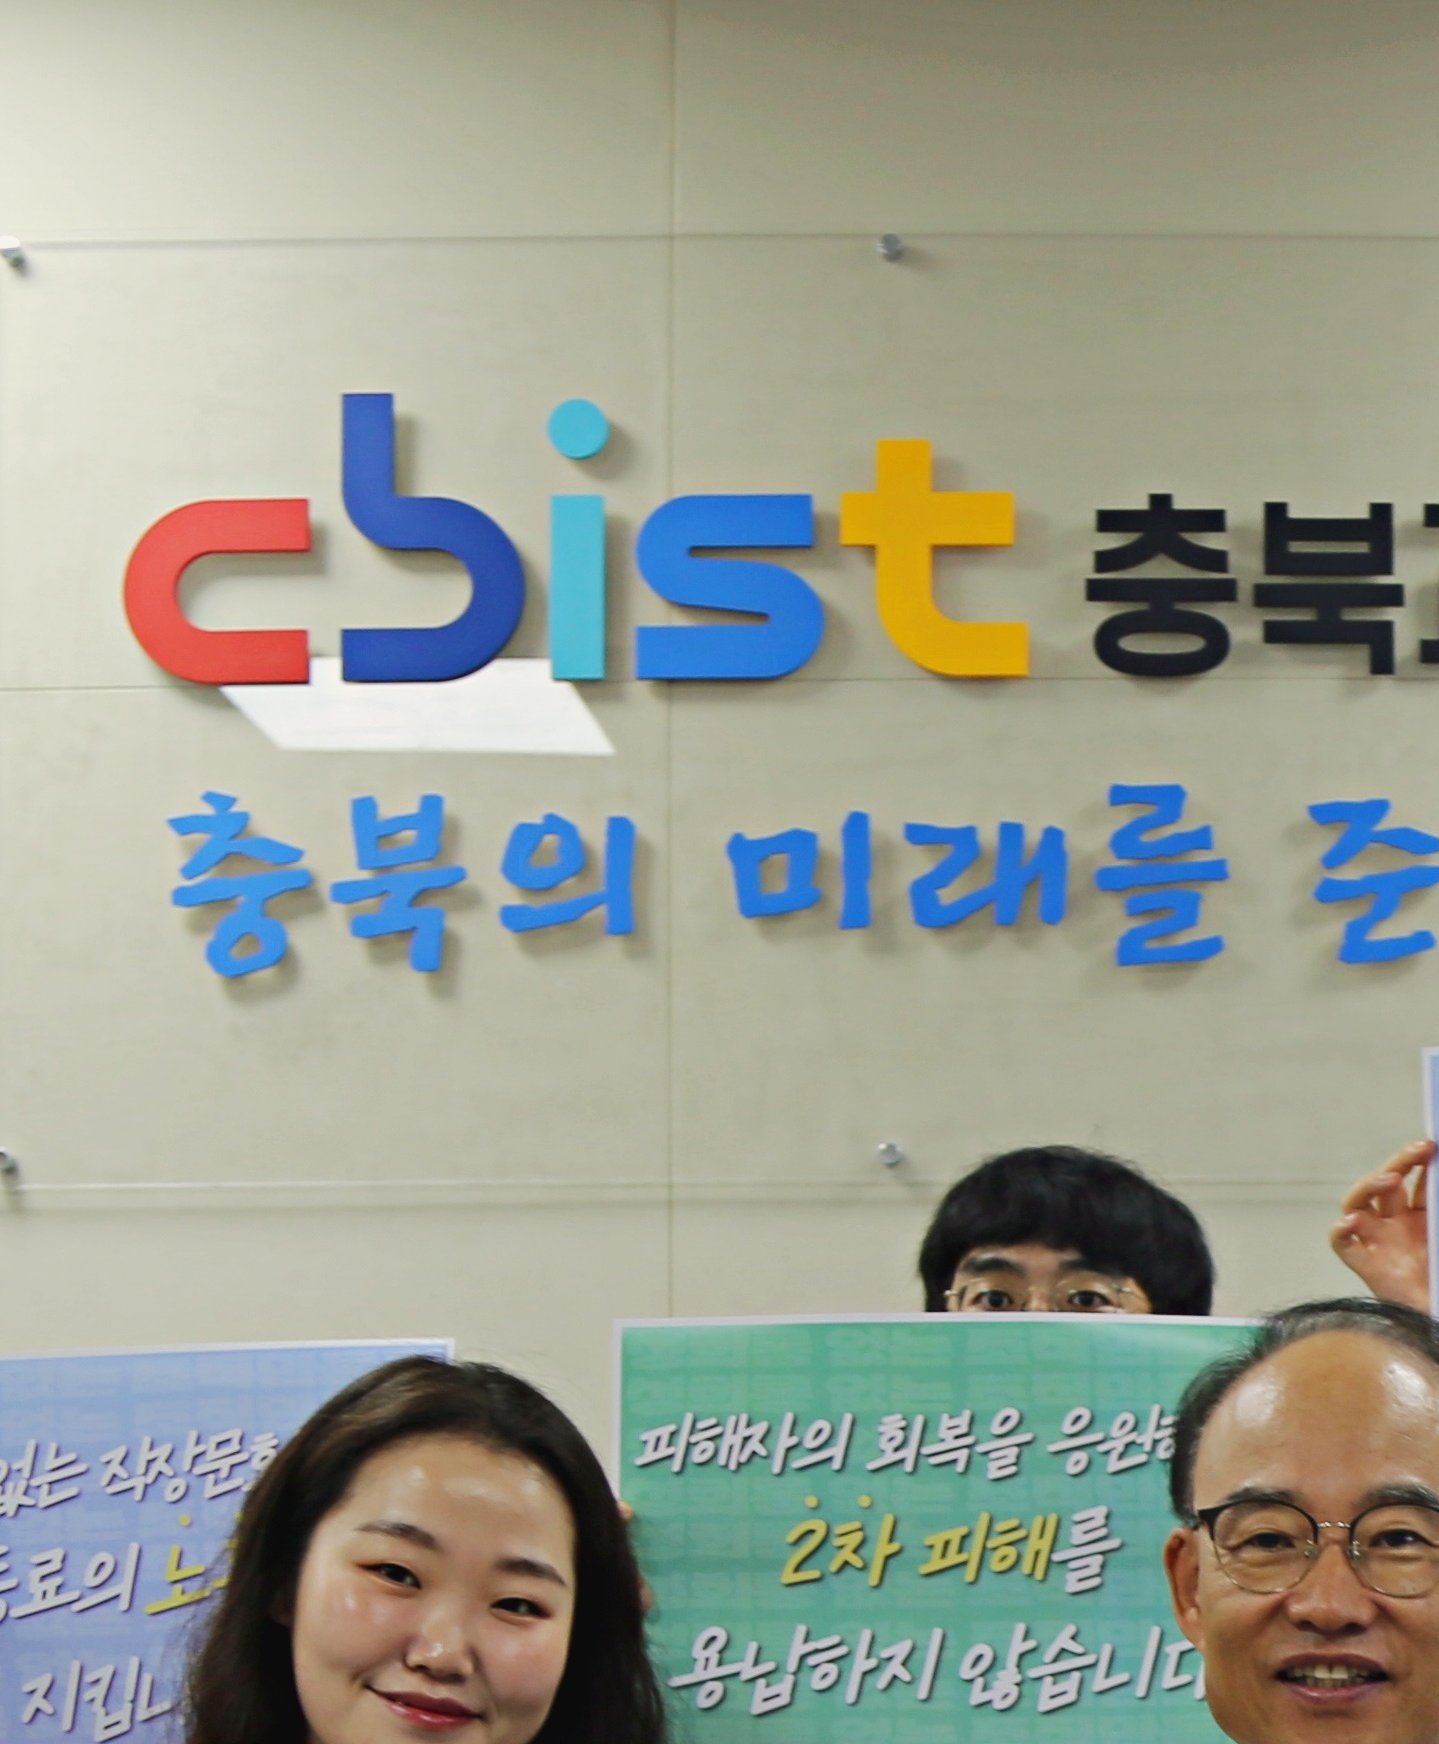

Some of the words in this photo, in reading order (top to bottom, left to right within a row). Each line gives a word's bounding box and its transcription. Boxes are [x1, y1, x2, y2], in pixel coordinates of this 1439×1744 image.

[125, 393, 1029, 683] cbist
[167, 793, 635, 979] 충북의
[727, 784, 1230, 968] 미래를
[634, 1412, 853, 1475] 피해자의
[865, 1408, 1034, 1480] 회복을
[779, 1511, 901, 1586] 2차
[918, 1505, 1121, 1594] 피해를
[667, 1624, 944, 1715] 용납하지
